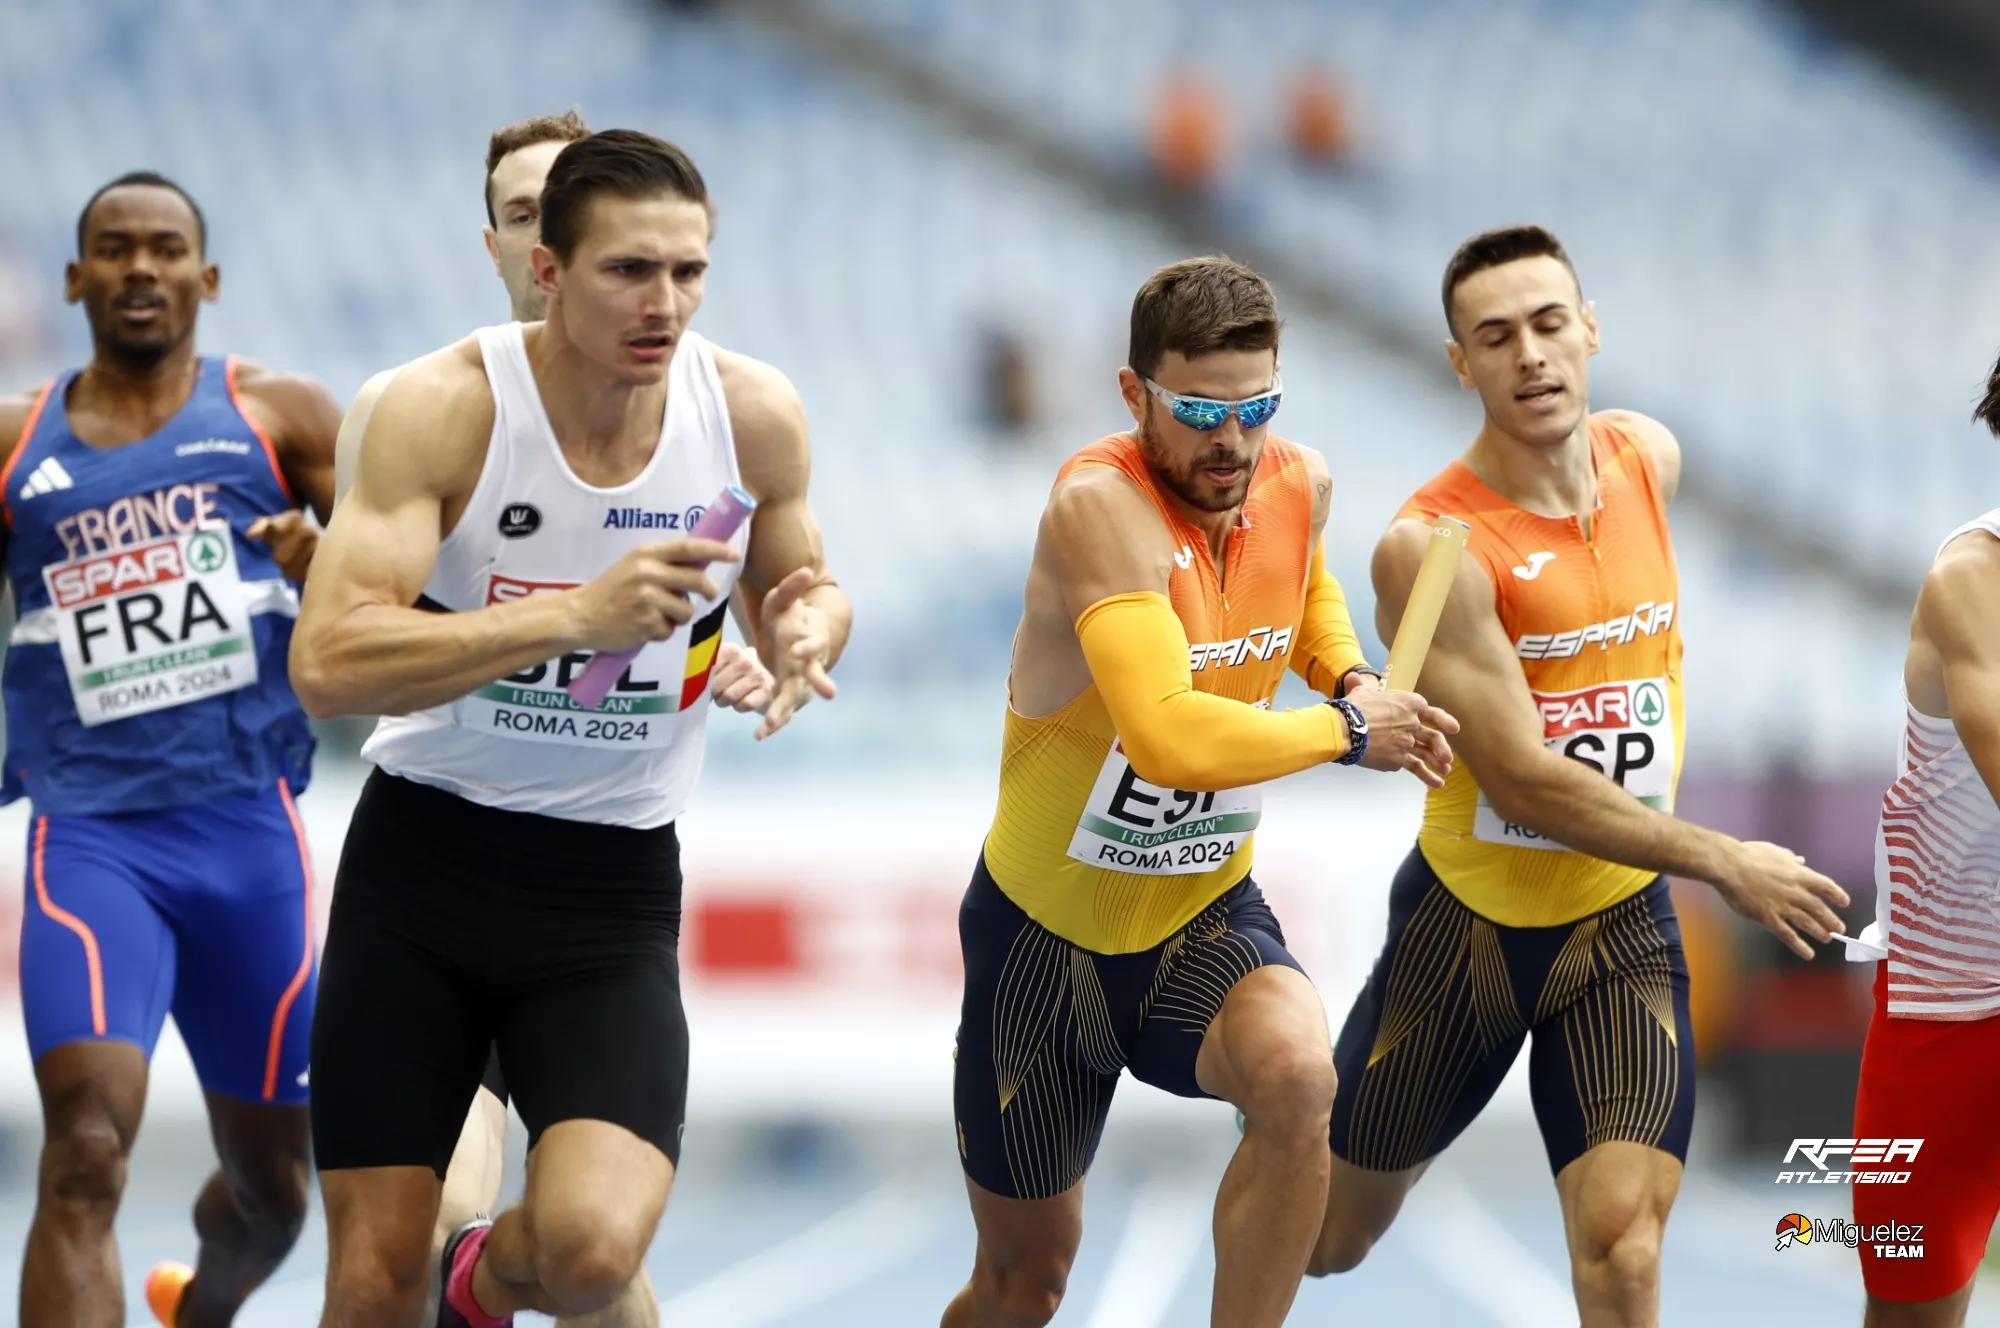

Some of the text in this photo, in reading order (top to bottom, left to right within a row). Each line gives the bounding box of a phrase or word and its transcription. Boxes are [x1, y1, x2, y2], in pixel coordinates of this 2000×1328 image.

[55, 483, 226, 561] FRANCE
[603, 507, 679, 529] Allianz
[55, 545, 181, 603] SPAR
[74, 581, 231, 665] FRA
[1515, 601, 1674, 660] ESPAÑA
[1188, 625, 1294, 671] SPAÑA
[98, 664, 232, 713] ROMA 2024
[512, 690, 519, 703] I
[522, 691, 564, 708] RUN
[1539, 691, 1628, 728] PAR
[493, 708, 649, 741] ROMA 2024
[1545, 732, 1655, 788] SP
[1098, 840, 1235, 869] ROMA 2024
[1121, 829, 1129, 841] I
[1130, 832, 1166, 847] RUN
